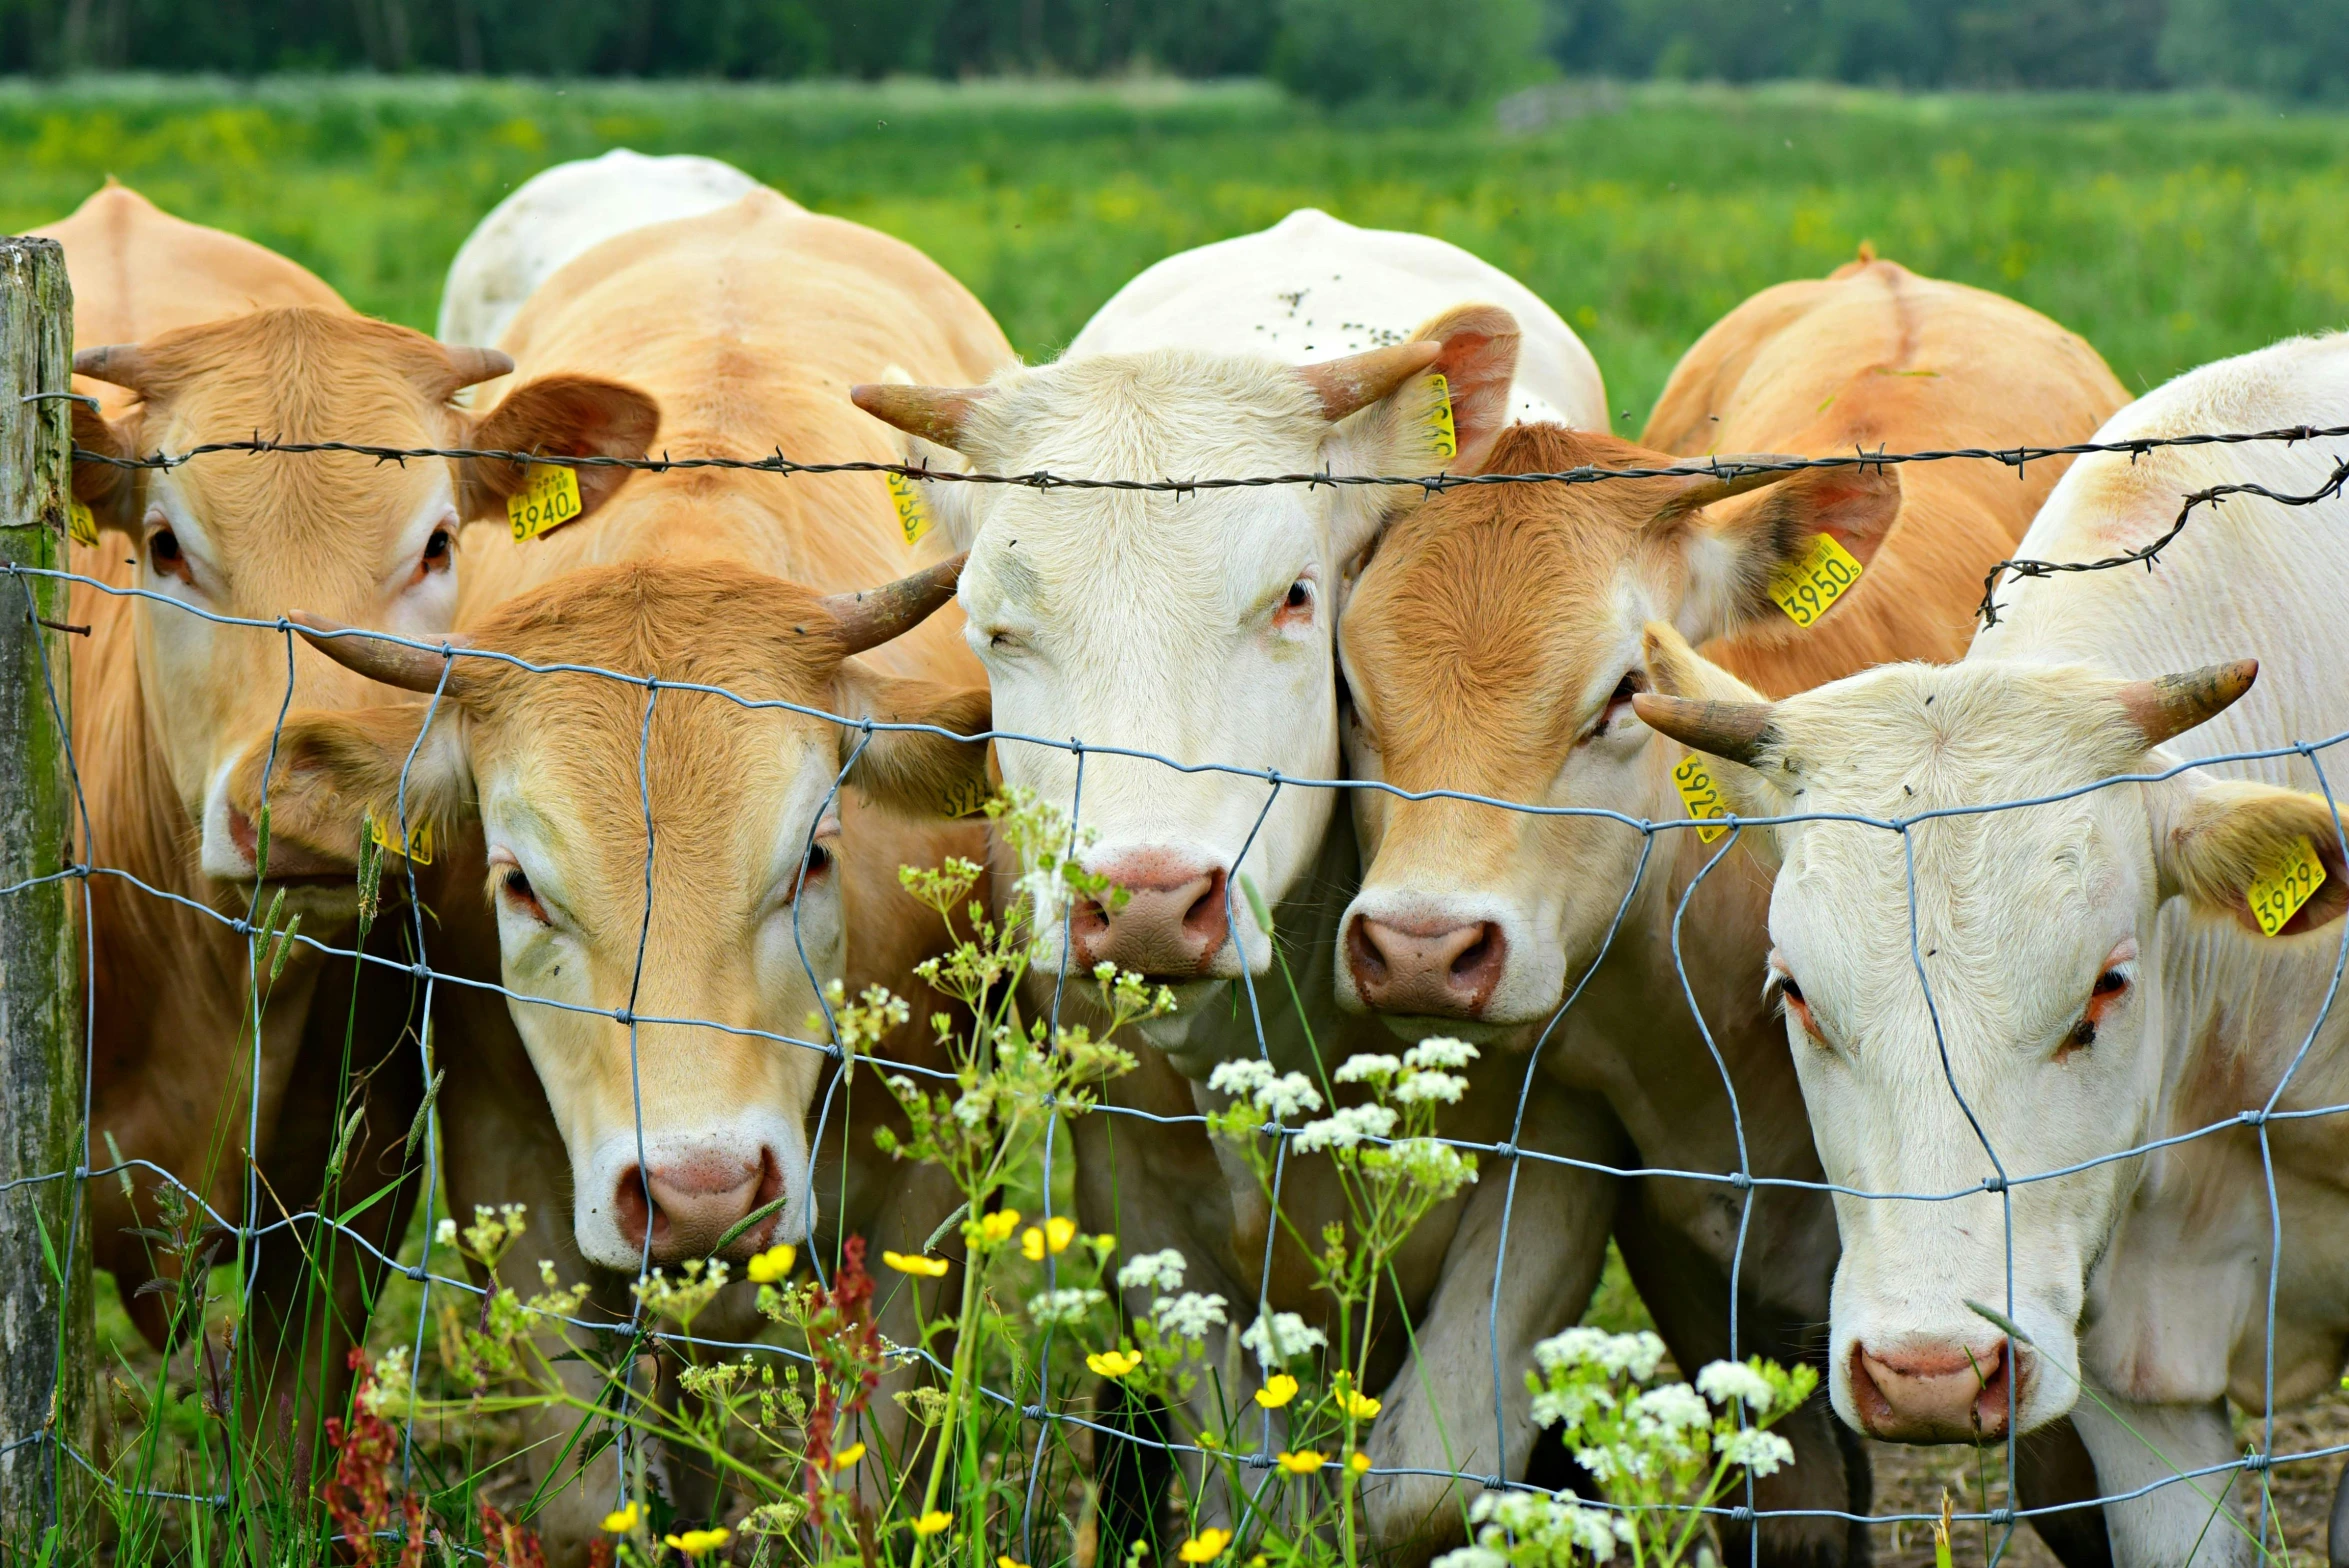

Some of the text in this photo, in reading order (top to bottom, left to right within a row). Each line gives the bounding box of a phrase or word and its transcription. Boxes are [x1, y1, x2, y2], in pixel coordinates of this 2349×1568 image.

[511, 492, 569, 539] 3940
[1783, 559, 1851, 623] 3950
[2258, 862, 2310, 932] 3929
